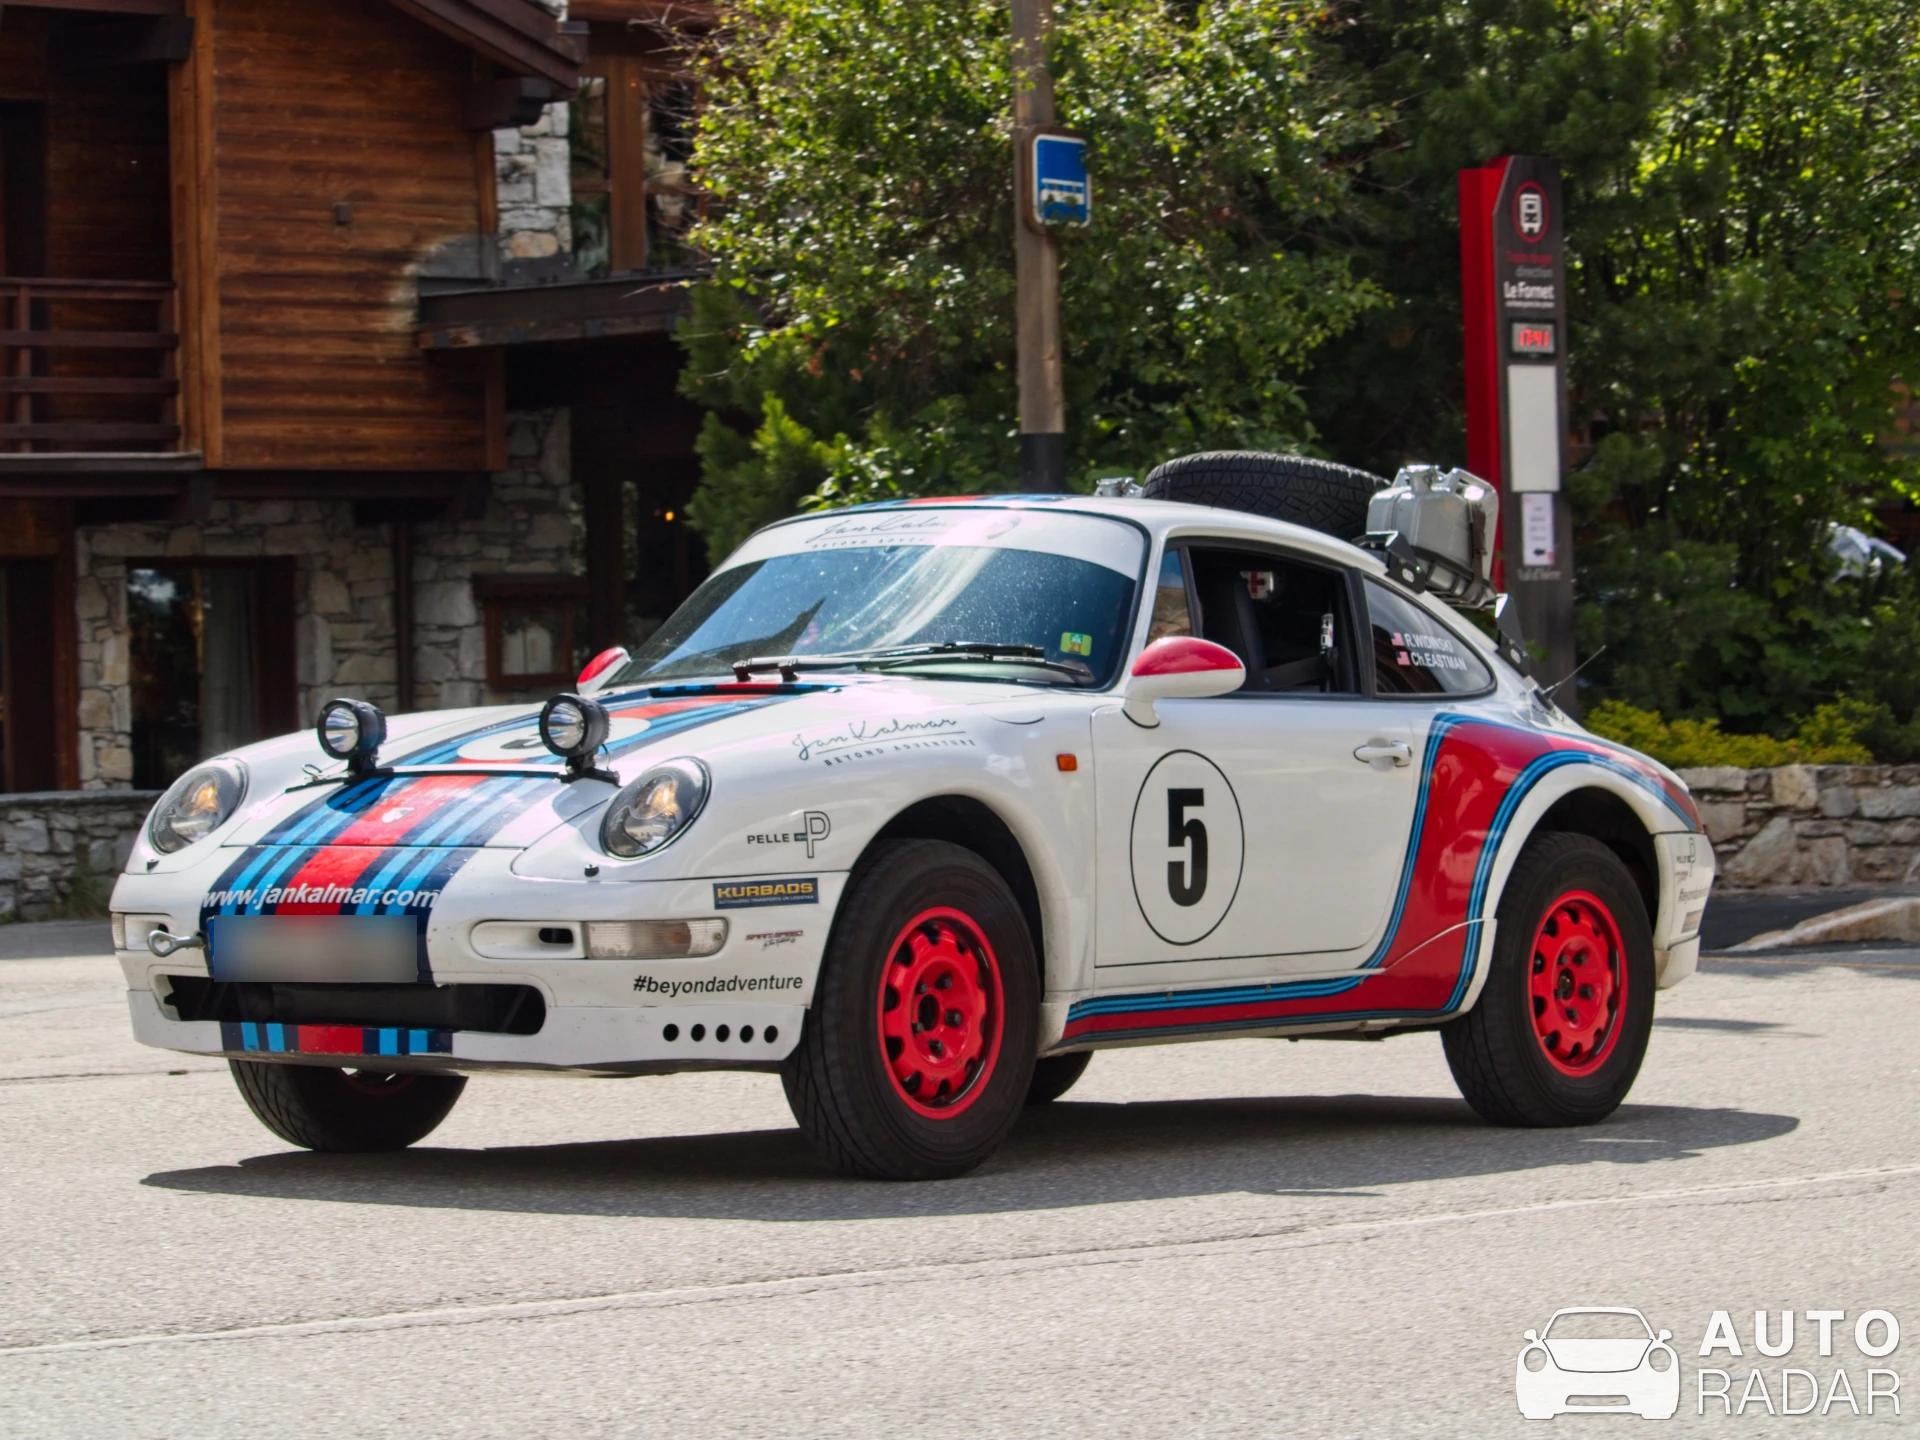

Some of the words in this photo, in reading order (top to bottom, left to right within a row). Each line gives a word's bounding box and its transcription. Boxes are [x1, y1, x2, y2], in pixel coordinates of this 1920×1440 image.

[1503, 281, 1517, 298] Le
[1411, 651, 1468, 671] Ch.EASTMAN
[792, 733, 848, 761] Jan
[849, 719, 956, 741] Kalmar
[824, 748, 885, 766] BEYOND
[894, 739, 976, 752] ADVENTURE
[747, 833, 790, 844] PELLE
[1167, 788, 1208, 907] 5
[202, 883, 440, 910] www.jankalmar.com
[717, 883, 814, 898] KURBADS
[633, 975, 803, 998] #beyondadventure
